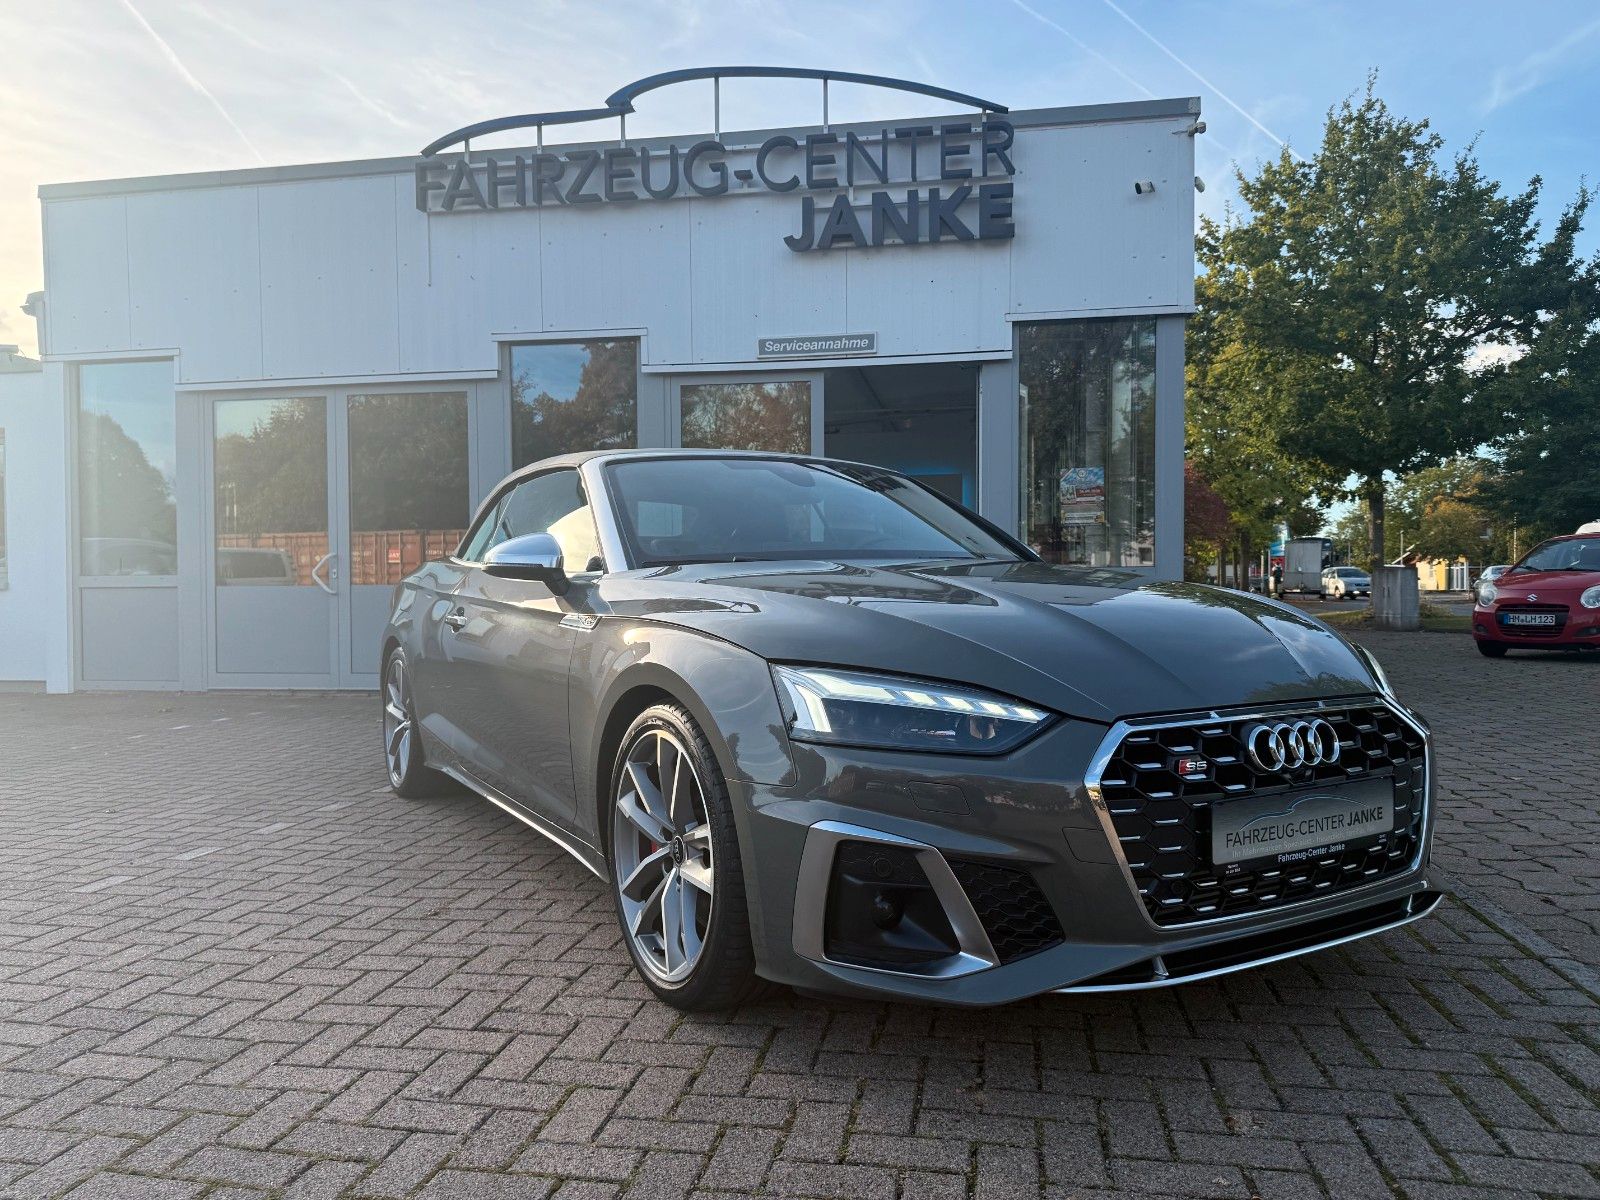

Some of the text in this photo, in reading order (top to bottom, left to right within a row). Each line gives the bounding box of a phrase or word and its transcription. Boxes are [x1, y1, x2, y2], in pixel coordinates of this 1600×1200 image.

[416, 120, 1015, 211] FAHRZEUG-CENTER
[783, 183, 1015, 252] JANKE
[764, 338, 869, 352] Serviceannahme
[1186, 761, 1208, 771] S5
[1226, 814, 1344, 848] FAHRZEUG-CENTER
[1347, 806, 1383, 827] JANKE
[1278, 843, 1345, 864] Fahrzeug-Center Janke
